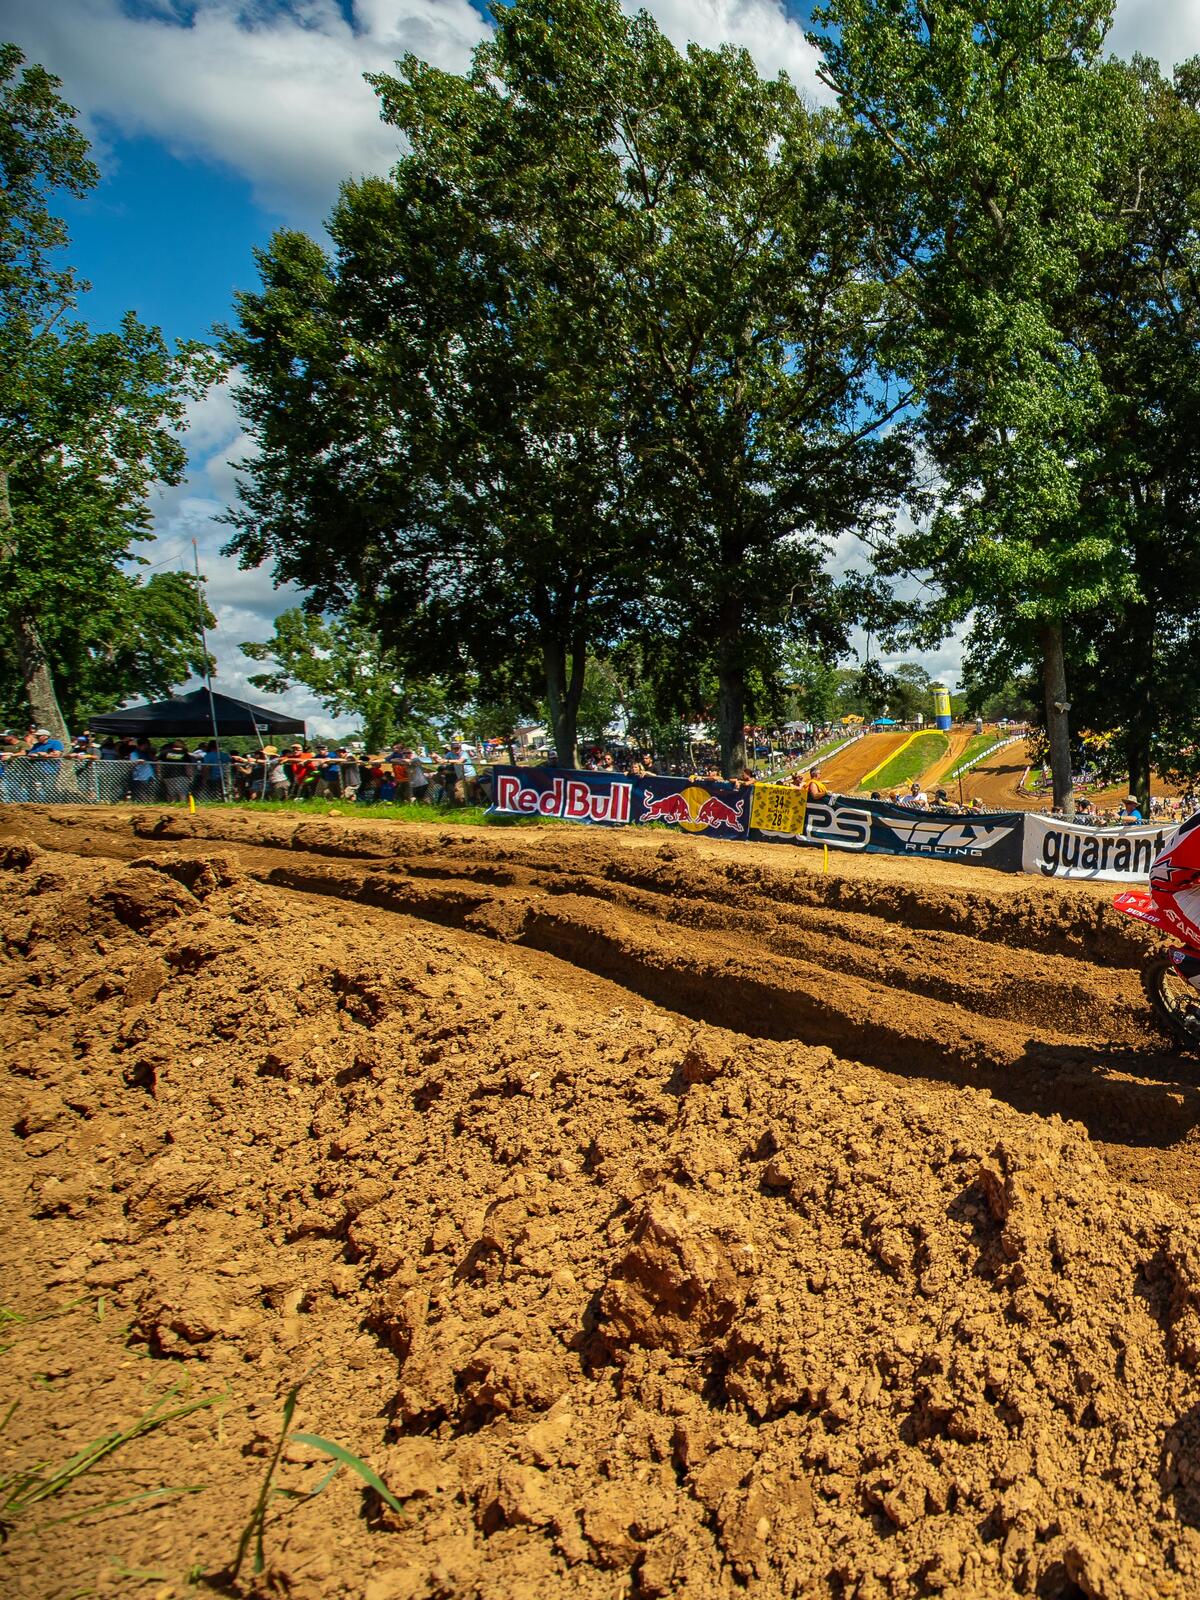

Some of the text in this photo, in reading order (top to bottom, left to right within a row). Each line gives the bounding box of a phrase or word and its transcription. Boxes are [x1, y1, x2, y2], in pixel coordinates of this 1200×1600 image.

[495, 775, 633, 824] Red Bull
[774, 795, 785, 809] 34
[771, 812, 783, 827] 28
[877, 816, 1015, 850] FLY
[904, 843, 983, 857] RACING
[1125, 907, 1161, 923] DUNLOP
